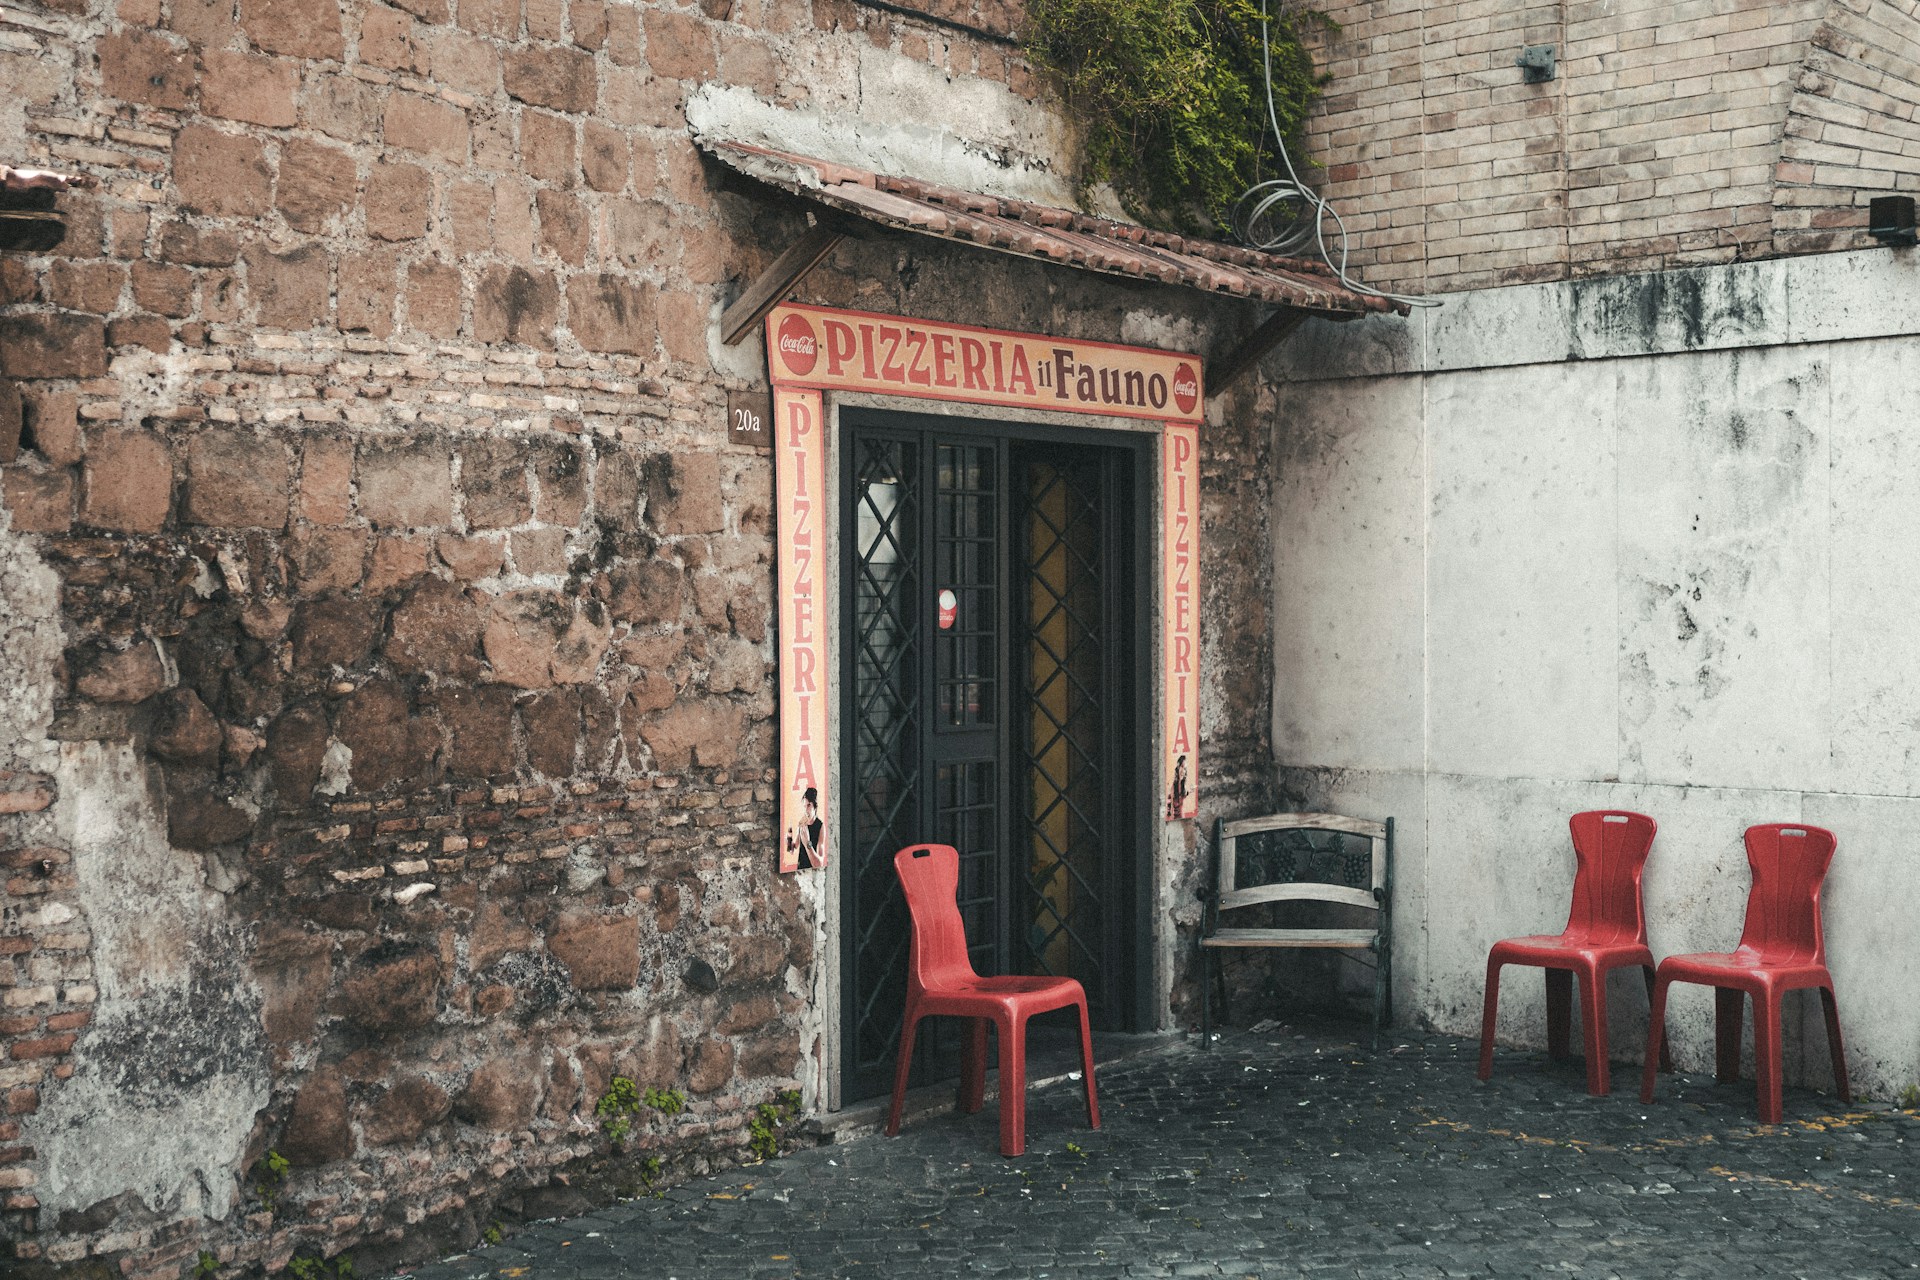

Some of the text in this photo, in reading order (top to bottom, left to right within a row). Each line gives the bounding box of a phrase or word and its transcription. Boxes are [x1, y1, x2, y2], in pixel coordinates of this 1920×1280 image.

[734, 408, 761, 432] 20a
[823, 319, 1168, 410] PIZZERIA il Fauno
[787, 401, 818, 791] PIZZERIA
[1173, 434, 1191, 754] PIZZERIA
